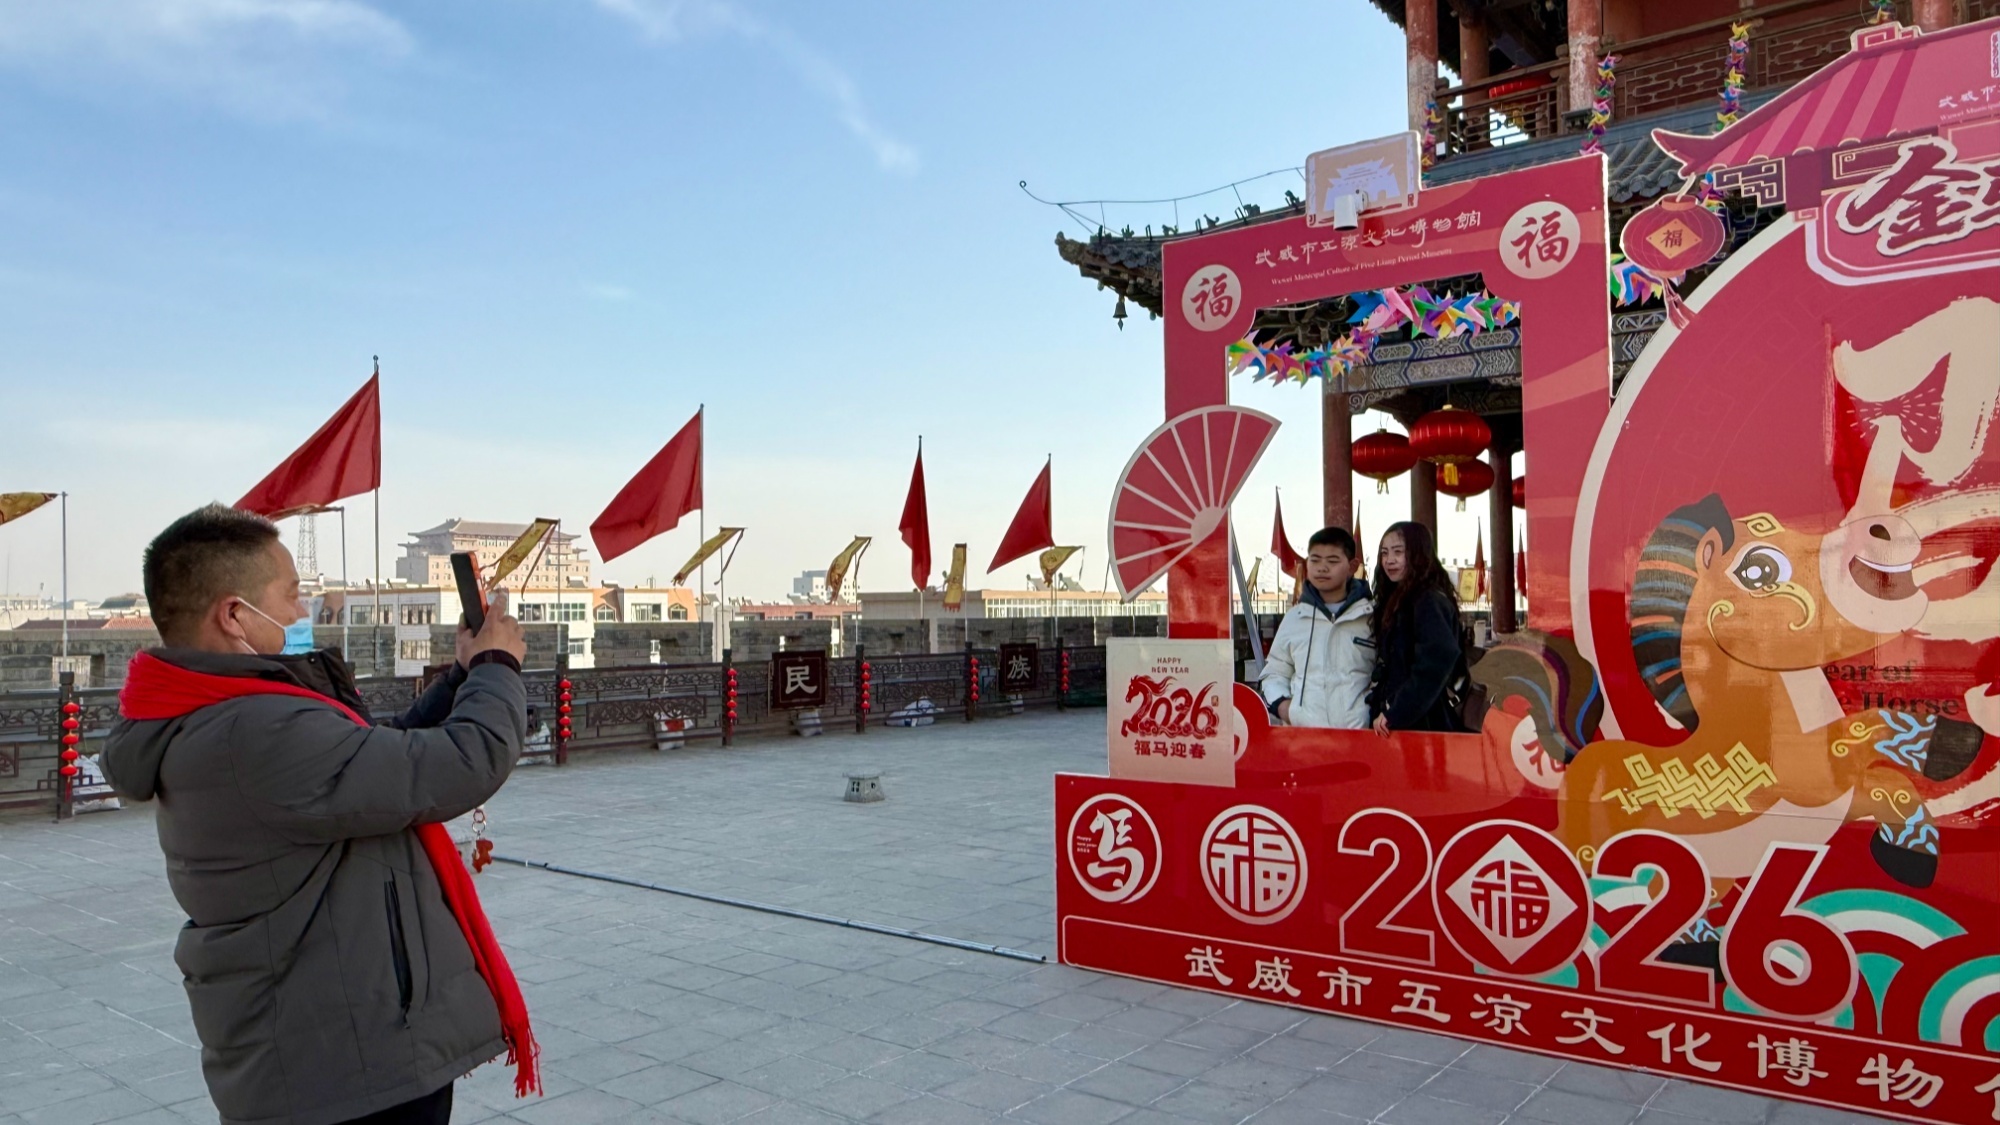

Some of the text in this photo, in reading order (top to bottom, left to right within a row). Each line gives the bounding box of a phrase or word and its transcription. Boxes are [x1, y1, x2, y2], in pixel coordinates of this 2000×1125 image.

[1511, 210, 1569, 268] 福
[1661, 229, 1683, 248] 福
[1294, 269, 1325, 280] Municipal
[1326, 265, 1350, 276] Culture
[1351, 263, 1360, 271] of
[1360, 261, 1376, 270] Five
[1376, 257, 1397, 267] Liang
[1397, 252, 1420, 263] Period
[1420, 247, 1453, 259] Museum
[1190, 272, 1233, 323] 福
[785, 665, 817, 694] 民
[1007, 655, 1032, 679] 族
[1824, 659, 1918, 682] ear of
[1121, 675, 1219, 740] 2026
[1862, 691, 1960, 715] Horse
[1134, 740, 1206, 759] 福马迎春
[1210, 816, 1297, 916] 福
[1470, 858, 1551, 938] 福
